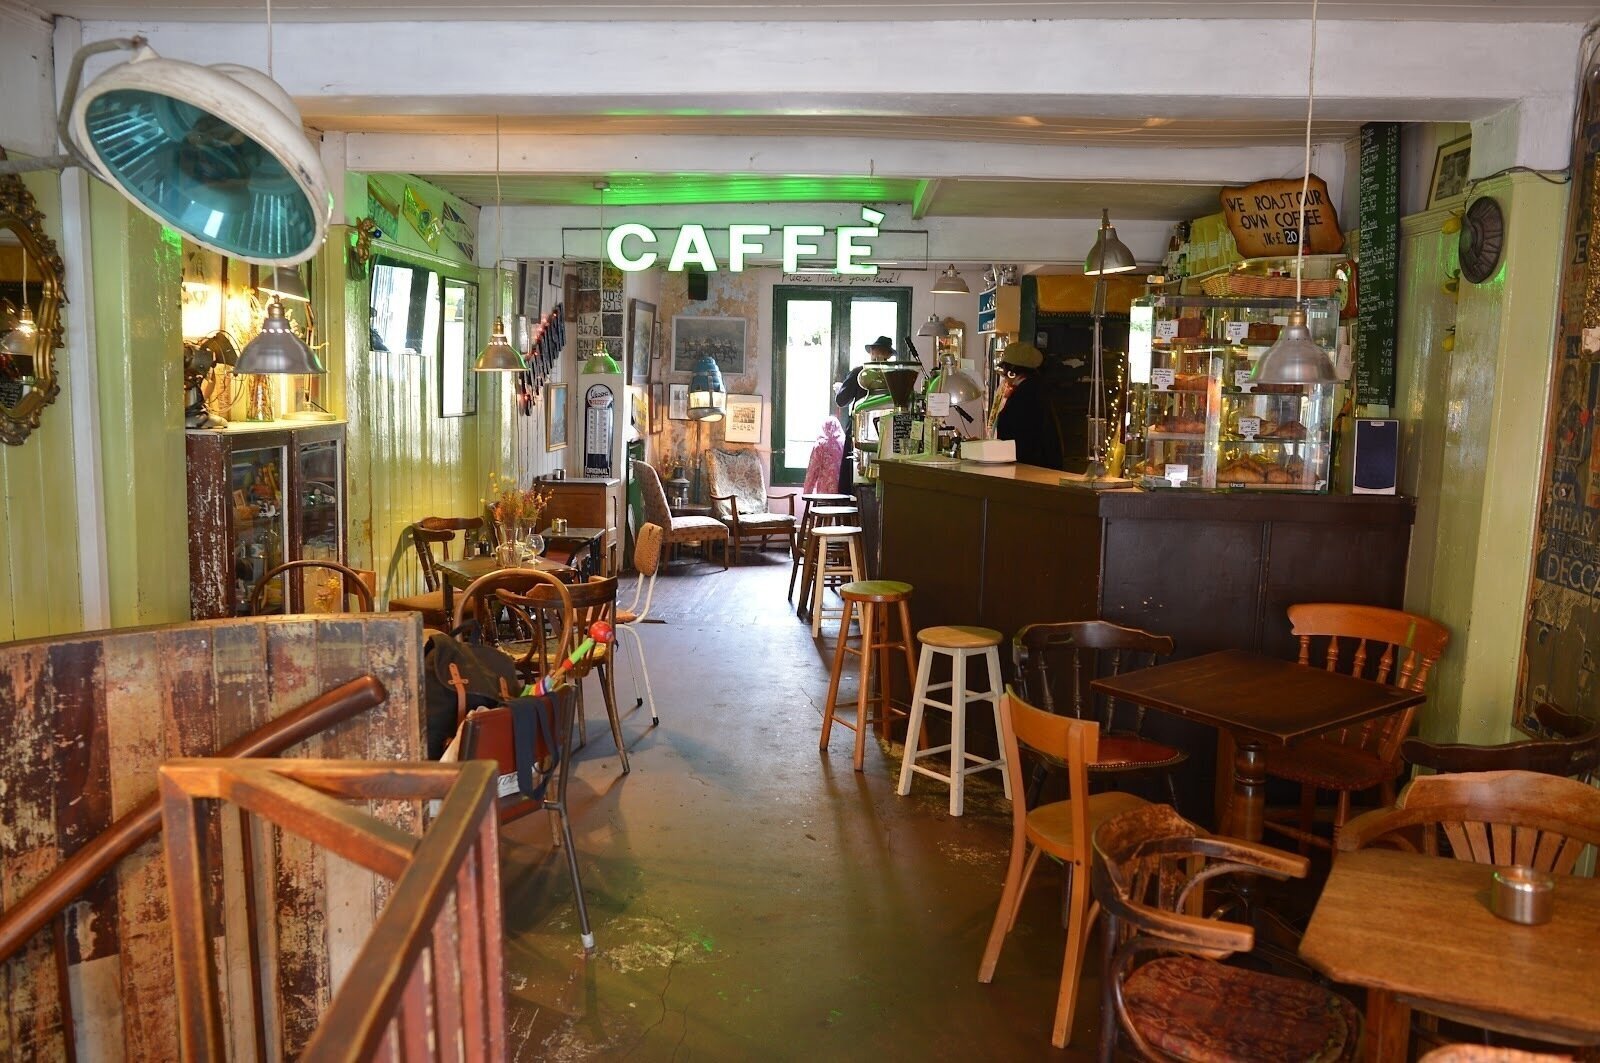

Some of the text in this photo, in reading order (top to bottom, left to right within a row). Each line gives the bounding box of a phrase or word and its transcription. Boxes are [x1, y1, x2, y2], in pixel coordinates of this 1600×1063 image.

[1226, 197, 1246, 213] WE
[1254, 192, 1295, 211] ROAST
[1240, 208, 1323, 230] OWN COFEE
[1285, 230, 1298, 243] 20
[578, 325, 599, 335] 3476
